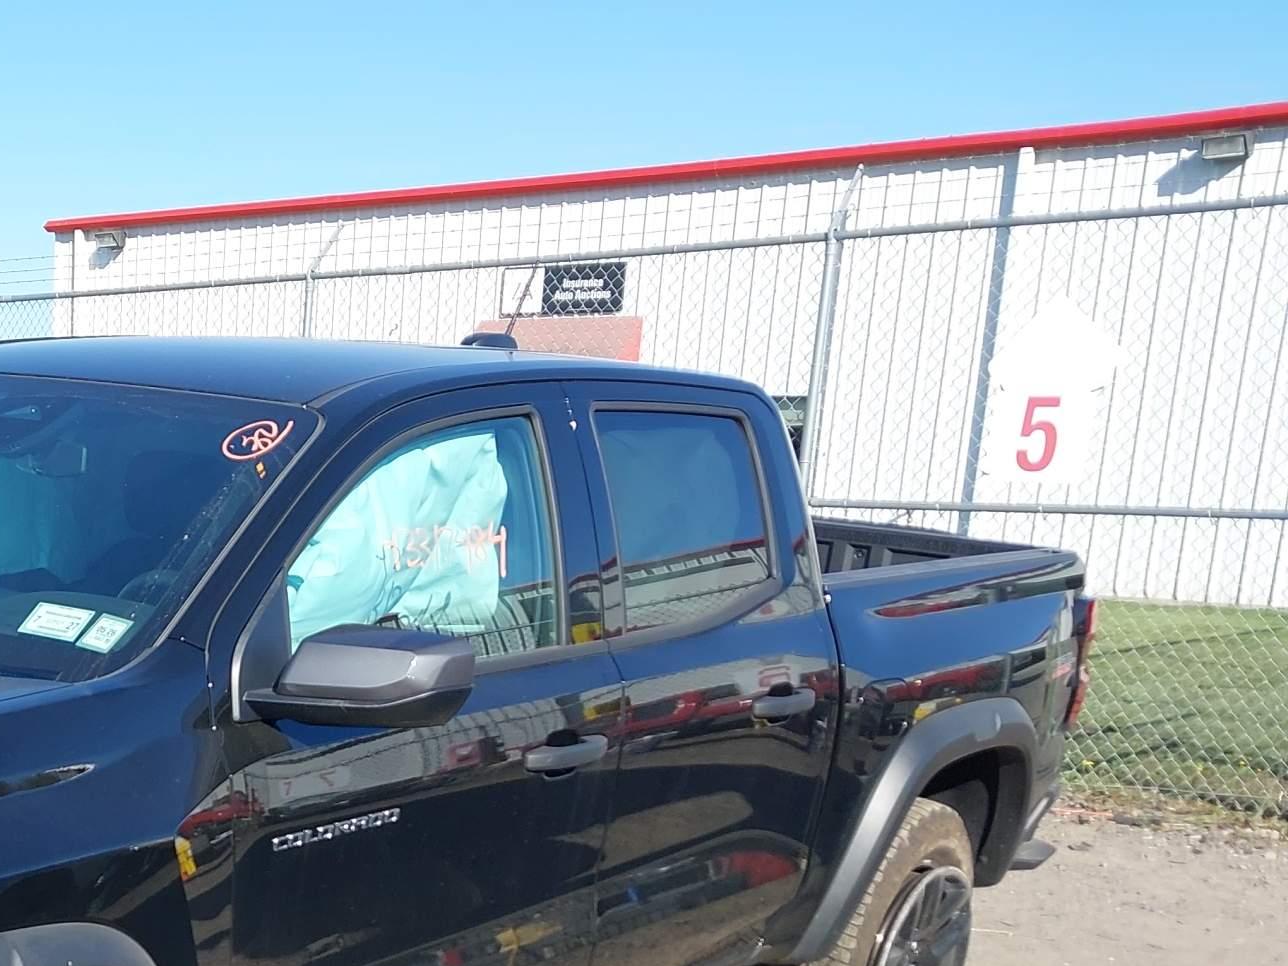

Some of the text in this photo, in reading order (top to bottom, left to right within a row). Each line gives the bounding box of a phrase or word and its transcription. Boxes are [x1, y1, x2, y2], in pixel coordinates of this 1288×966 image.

[554, 288, 611, 300] Auto Auctions
[562, 278, 604, 289] Insurance
[1015, 396, 1062, 472] 5
[271, 807, 401, 852] COLORADO
